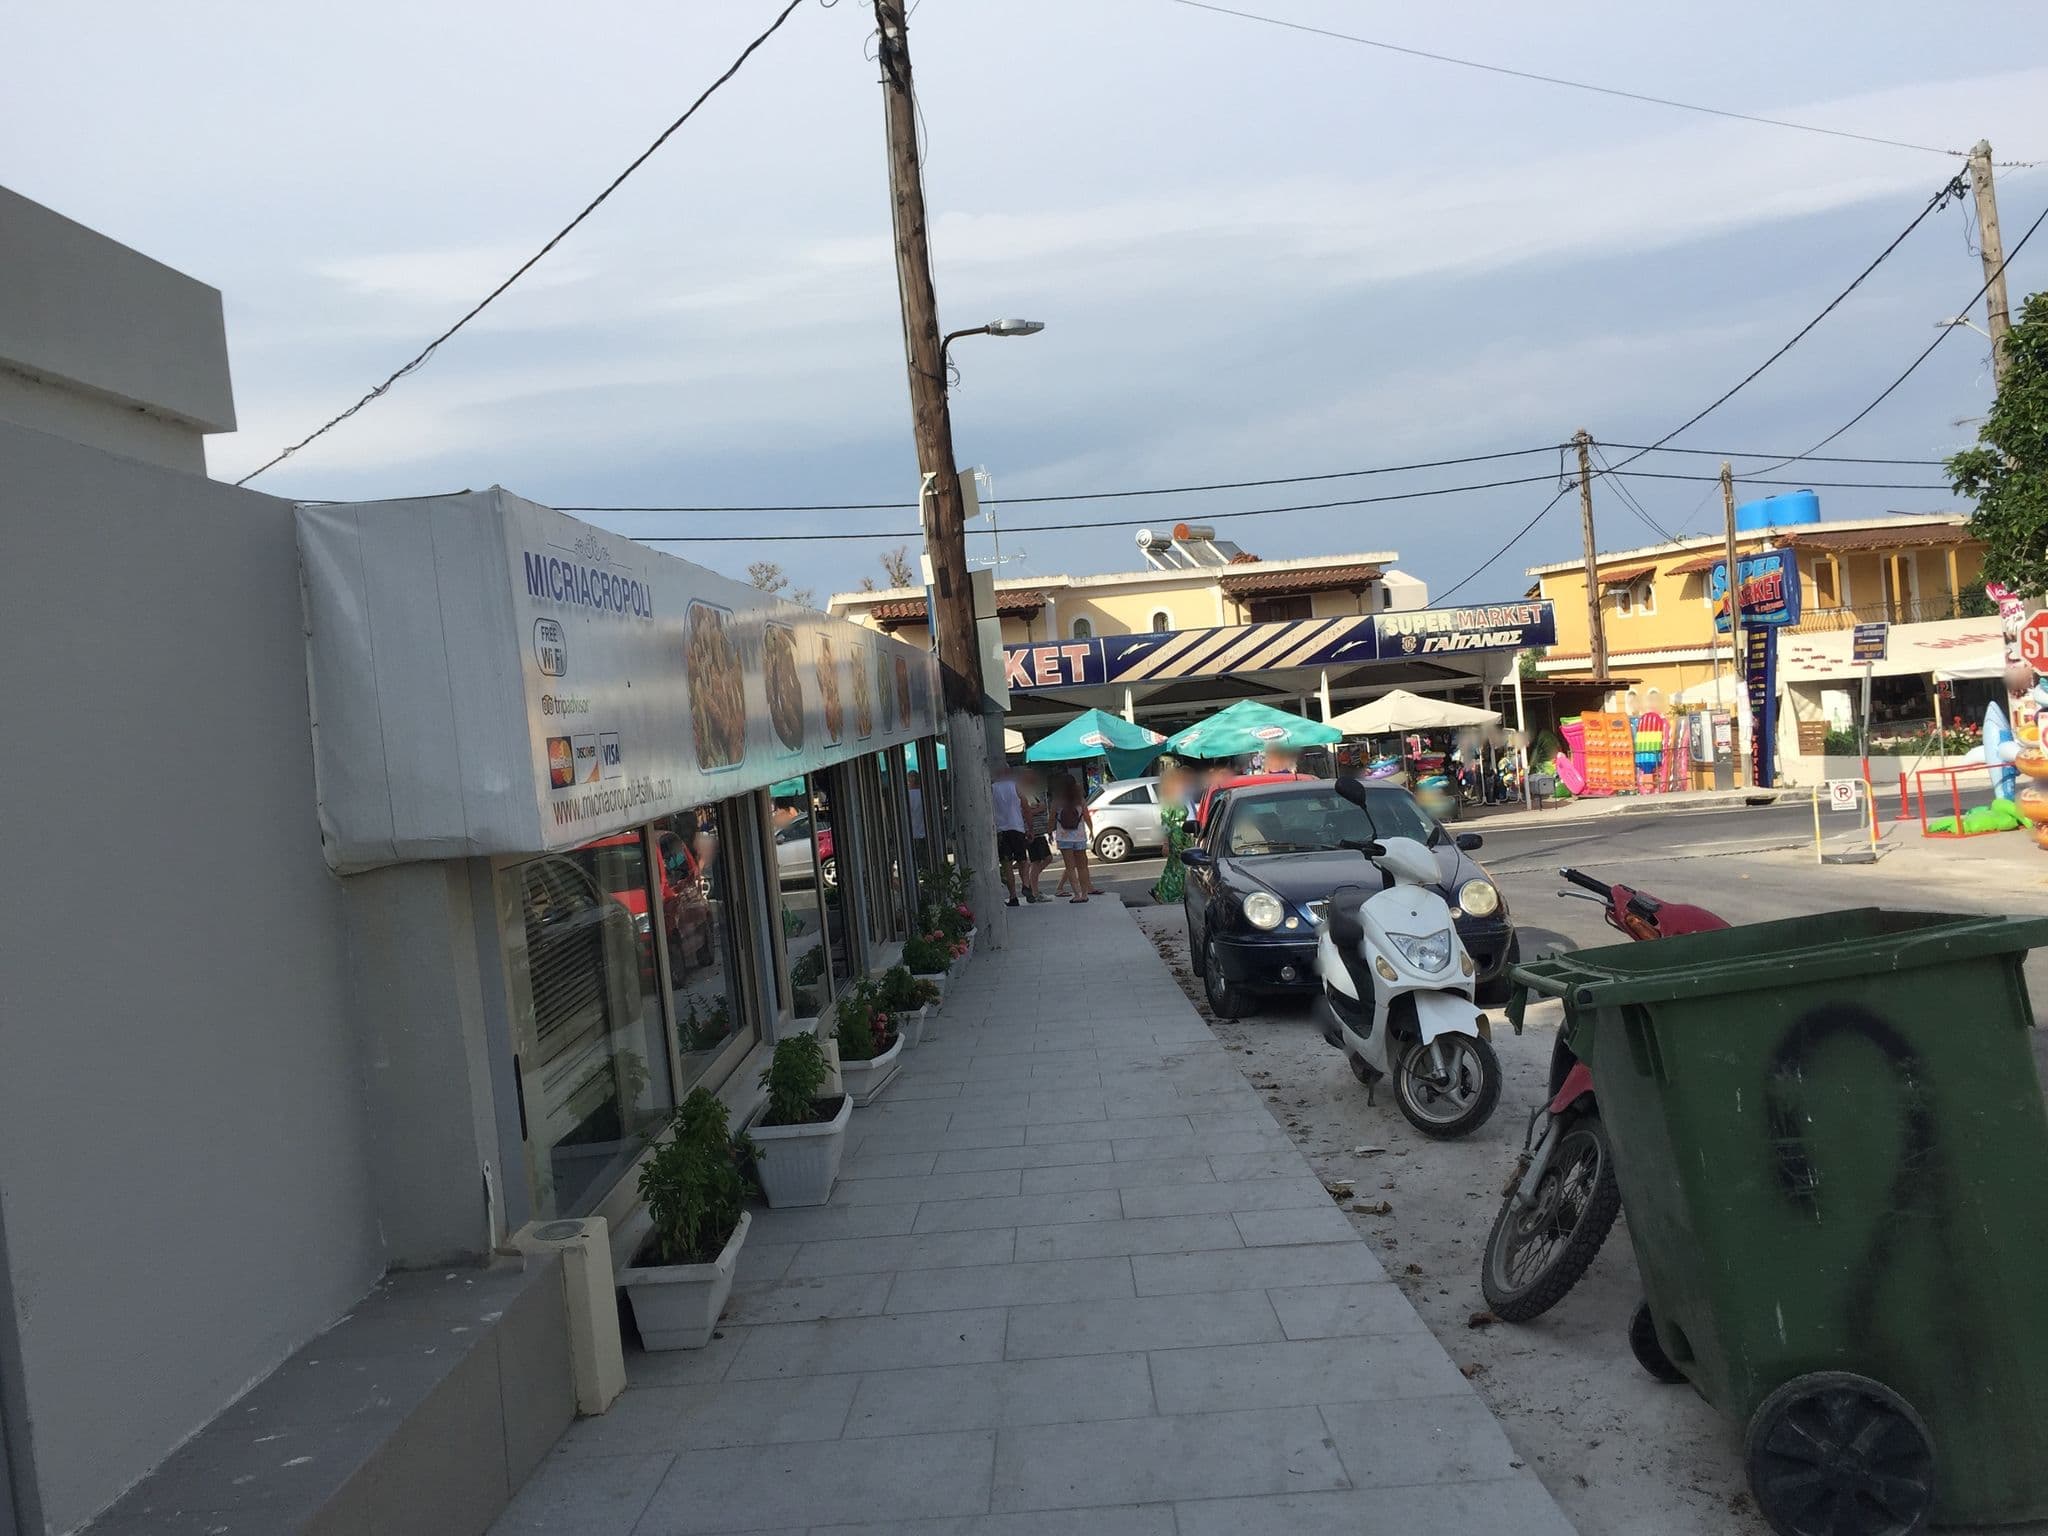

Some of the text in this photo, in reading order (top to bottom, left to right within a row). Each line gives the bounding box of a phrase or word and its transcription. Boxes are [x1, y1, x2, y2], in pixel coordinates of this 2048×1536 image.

[524, 551, 653, 619] MICRIACROPOLI
[540, 625, 559, 643] FREE
[1383, 603, 1543, 637] SUPER MARKET
[602, 743, 621, 766] VISA
